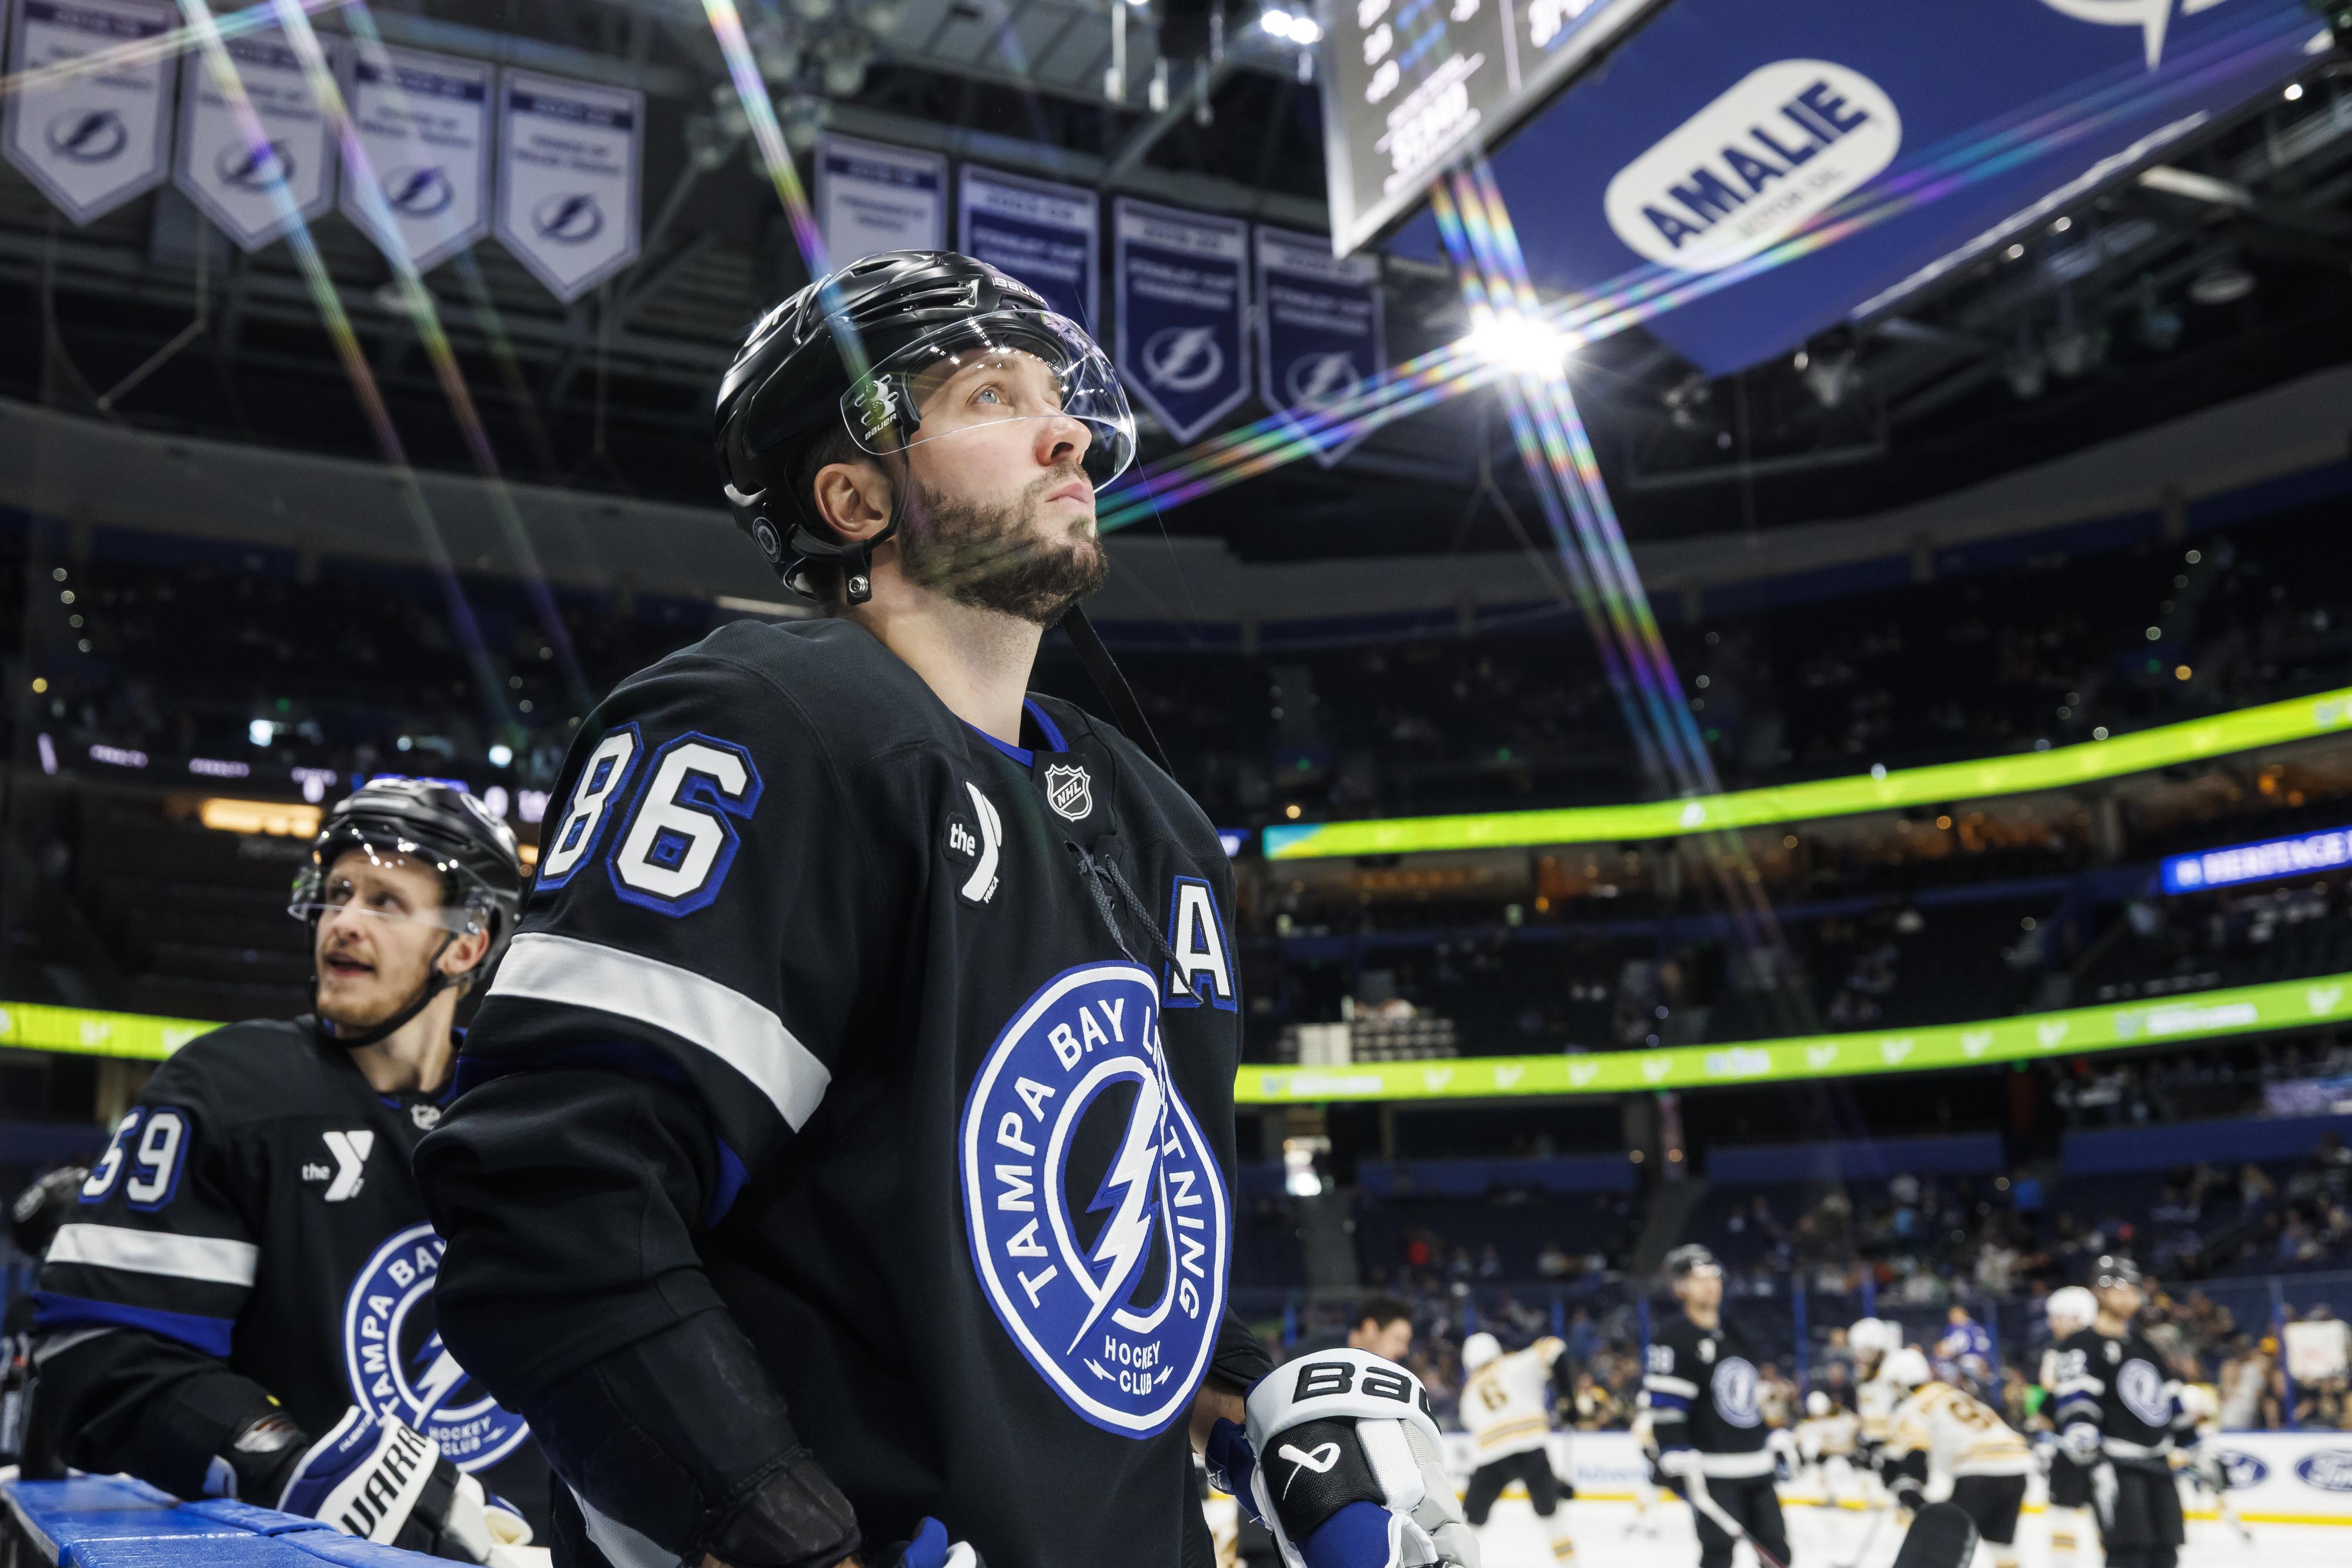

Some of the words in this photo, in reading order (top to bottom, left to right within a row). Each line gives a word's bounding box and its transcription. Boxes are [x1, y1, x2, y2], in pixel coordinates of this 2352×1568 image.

[1642, 81, 1869, 248] AMALIE
[1057, 781, 1082, 808] NHL
[539, 728, 756, 907] 86
[950, 823, 975, 857] the
[1167, 880, 1232, 1004] A
[81, 1109, 187, 1207] 59
[302, 1162, 330, 1181] the
[995, 1076, 1058, 1309] TAMPA
[1048, 998, 1124, 1072] BAY
[1142, 1006, 1205, 1319] LITNING
[361, 1295, 401, 1423] TAMPA
[1105, 1335, 1160, 1370] HOCKEY
[1120, 1370, 1152, 1396] CLUB
[428, 1415, 492, 1441] HOCKEY
[441, 1436, 482, 1456] CLUB
